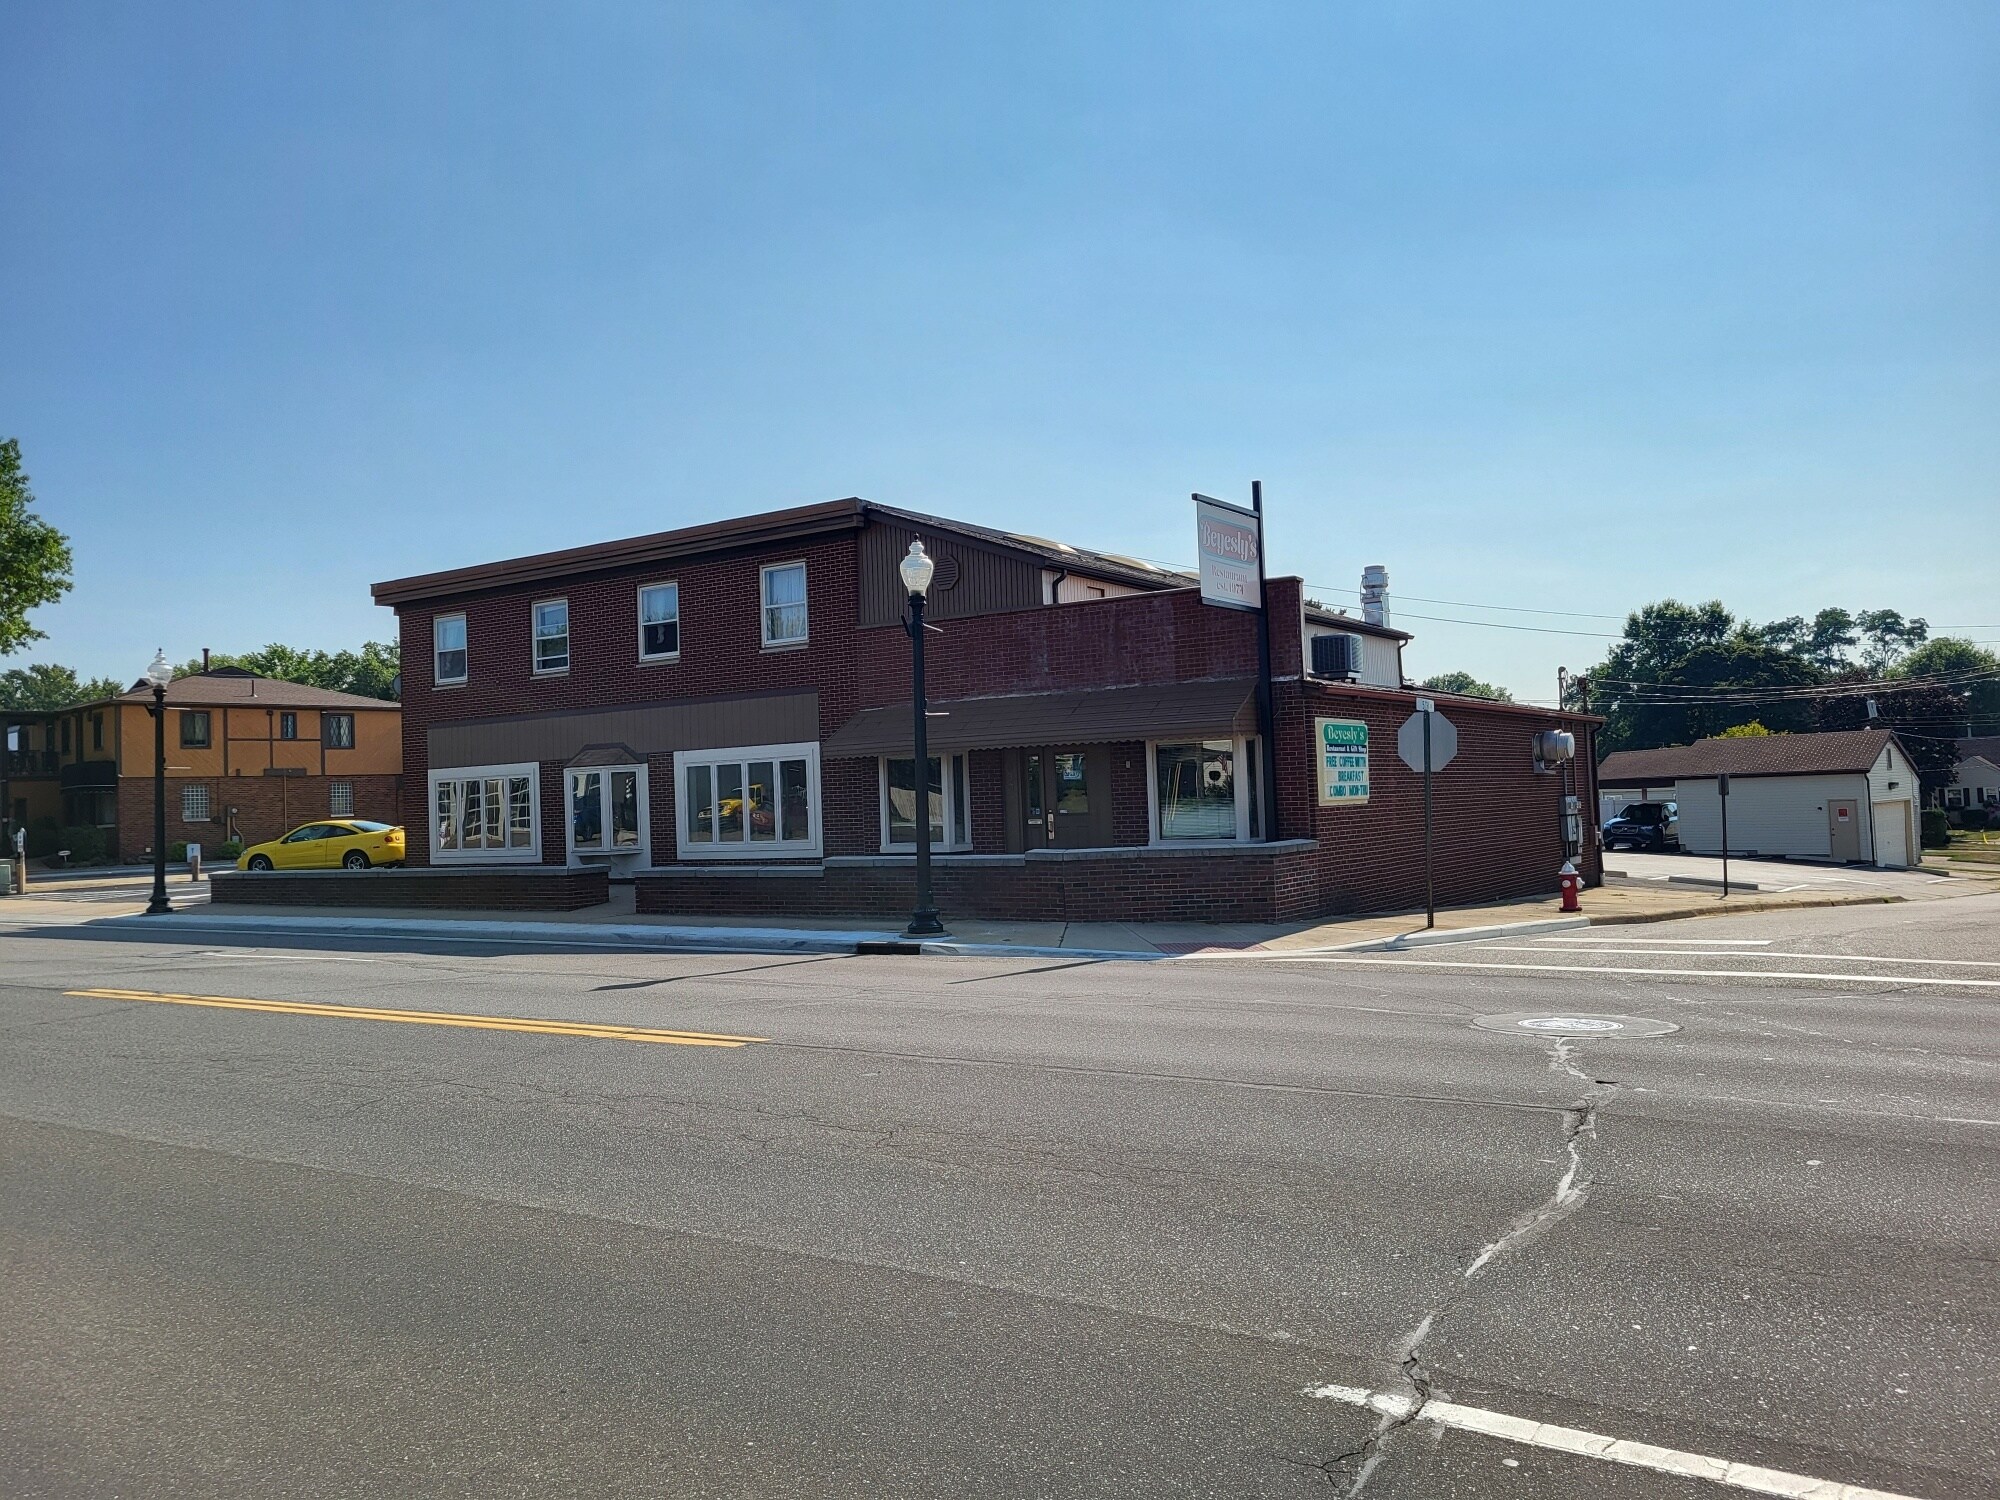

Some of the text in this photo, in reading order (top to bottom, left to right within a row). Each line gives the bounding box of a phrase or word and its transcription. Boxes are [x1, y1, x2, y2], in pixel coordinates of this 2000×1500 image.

[1201, 521, 1257, 561] Beyesly's
[1328, 725, 1364, 744] Beyesly's
[1326, 756, 1337, 767] FREE
[1340, 756, 1354, 767] COFFEE
[1338, 770, 1364, 782] BREAKFAST
[1330, 785, 1346, 797] COMBO
